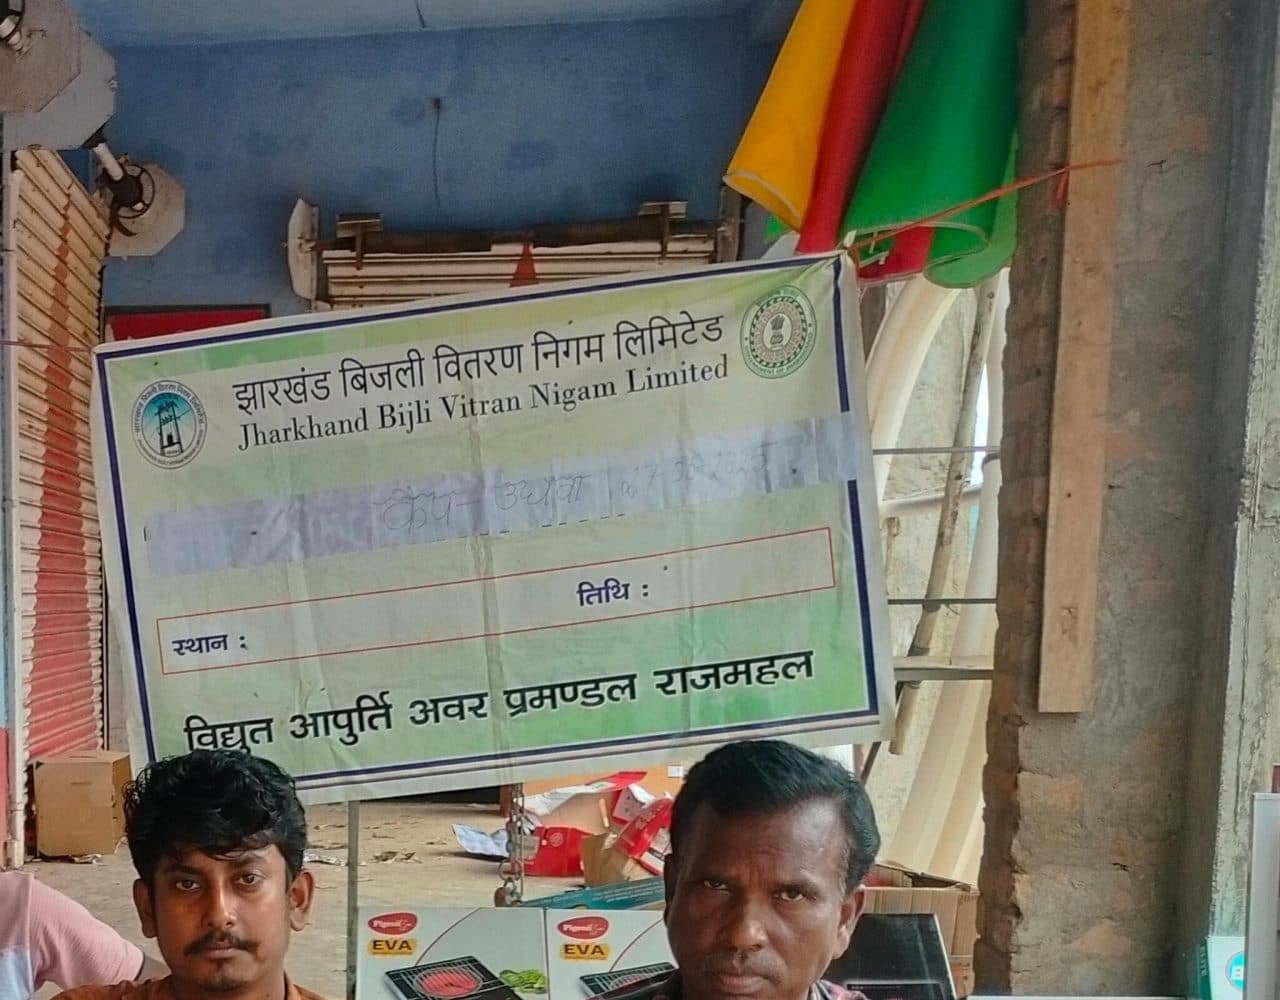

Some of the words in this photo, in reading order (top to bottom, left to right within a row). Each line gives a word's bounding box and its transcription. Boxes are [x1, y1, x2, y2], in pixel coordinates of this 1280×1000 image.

[232, 366, 331, 416] झारखंड
[339, 348, 425, 397] बिजली
[433, 344, 524, 384] वितरण
[531, 330, 606, 371] निगम
[613, 310, 724, 360] लिमिटेड
[238, 407, 370, 451] Jharkhand
[376, 399, 433, 434] Bijli
[439, 391, 523, 420] Vitran
[529, 382, 617, 412] Nigam
[625, 353, 728, 394] Limited
[577, 577, 630, 607] तिथि
[172, 632, 228, 656] स्थान
[289, 690, 393, 746] आपुर्ति
[409, 692, 489, 726] अवर
[503, 672, 638, 718] प्रमण्डल
[653, 650, 814, 696] राजमहल
[372, 939, 412, 951] EVA
[564, 943, 605, 956] EVA
